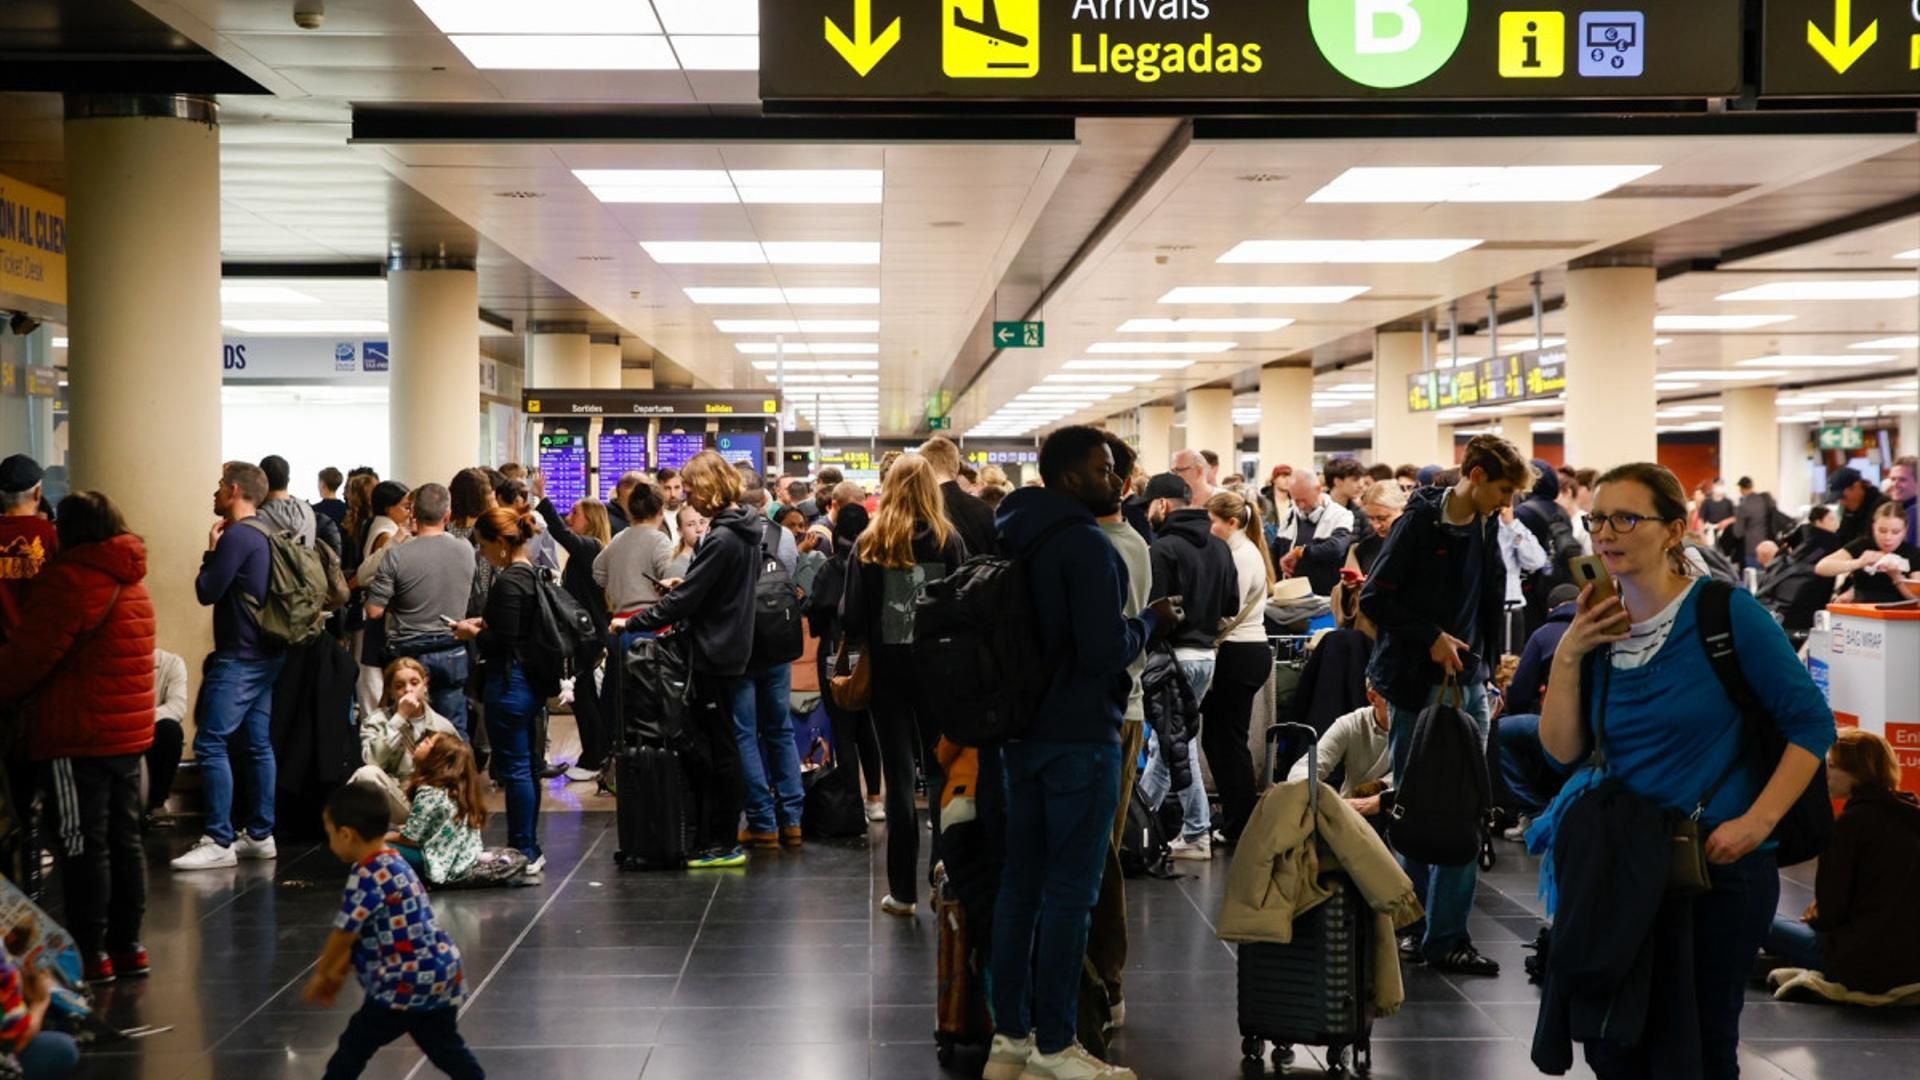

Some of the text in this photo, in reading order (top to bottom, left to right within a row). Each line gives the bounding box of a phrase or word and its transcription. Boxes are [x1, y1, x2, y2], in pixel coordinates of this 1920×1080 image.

[1071, 33, 1262, 82] Llegadas
[571, 403, 603, 413] Sortides
[633, 404, 675, 416] Departures
